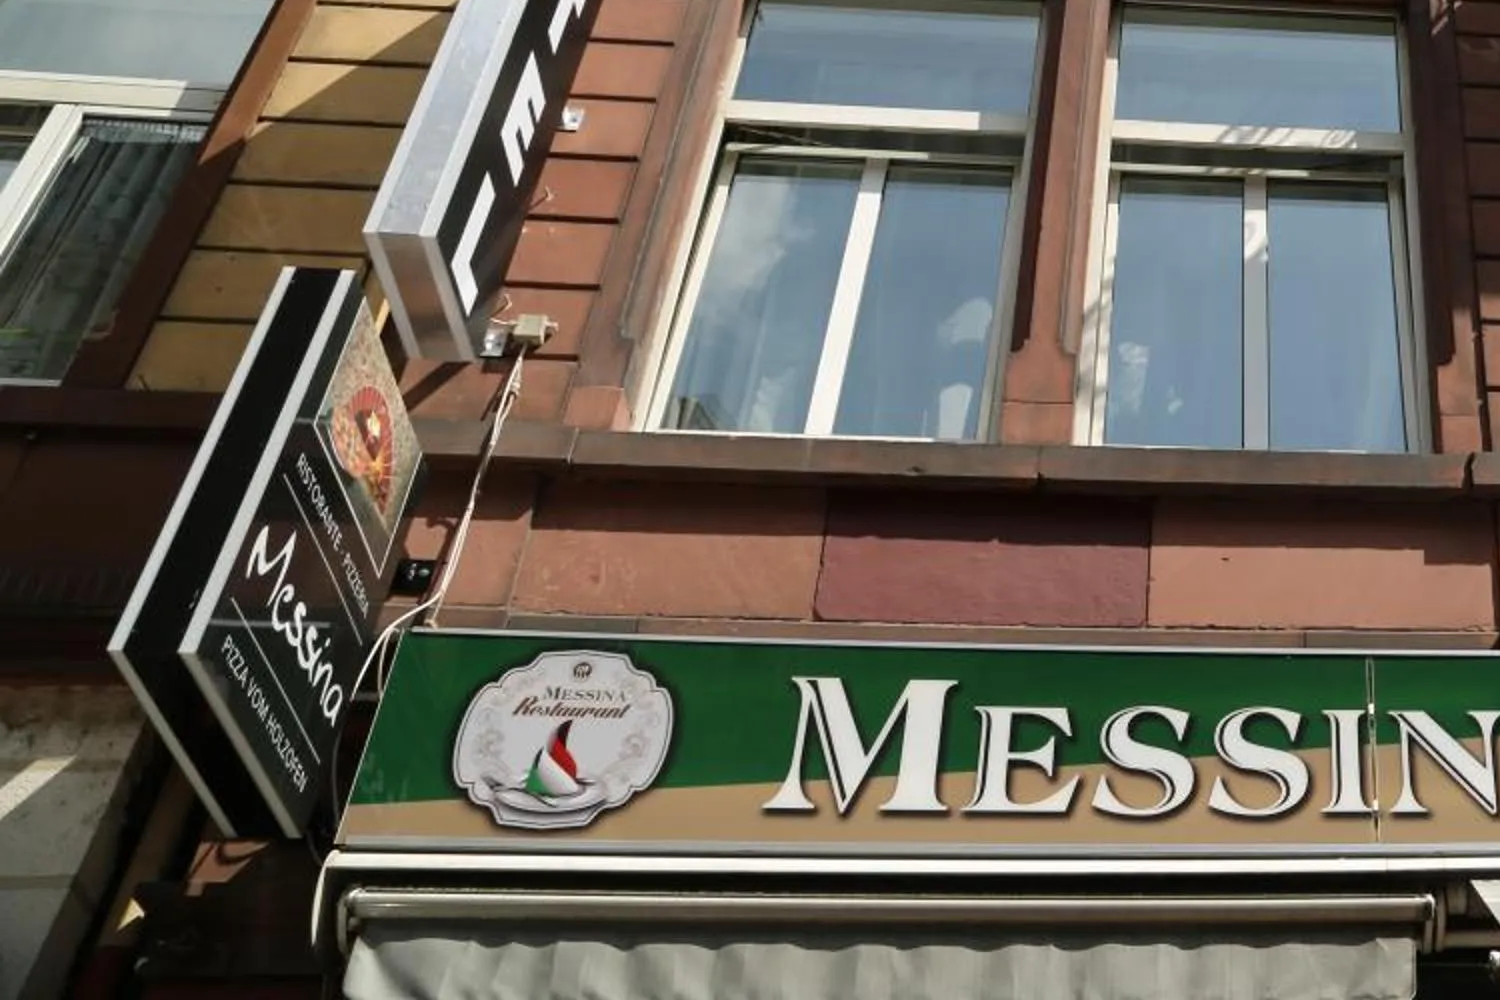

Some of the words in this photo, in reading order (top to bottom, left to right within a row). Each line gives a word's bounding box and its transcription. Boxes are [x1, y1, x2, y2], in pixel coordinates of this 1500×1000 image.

[296, 452, 343, 552] RISTORANTE
[342, 552, 370, 618] PIZZERIA
[246, 525, 344, 726] Messina
[543, 686, 628, 702] MESSINA
[221, 634, 249, 689] PIZZA
[247, 676, 270, 722] VOM
[265, 713, 309, 792] HOLZOFEN
[512, 697, 633, 720] Restaurant
